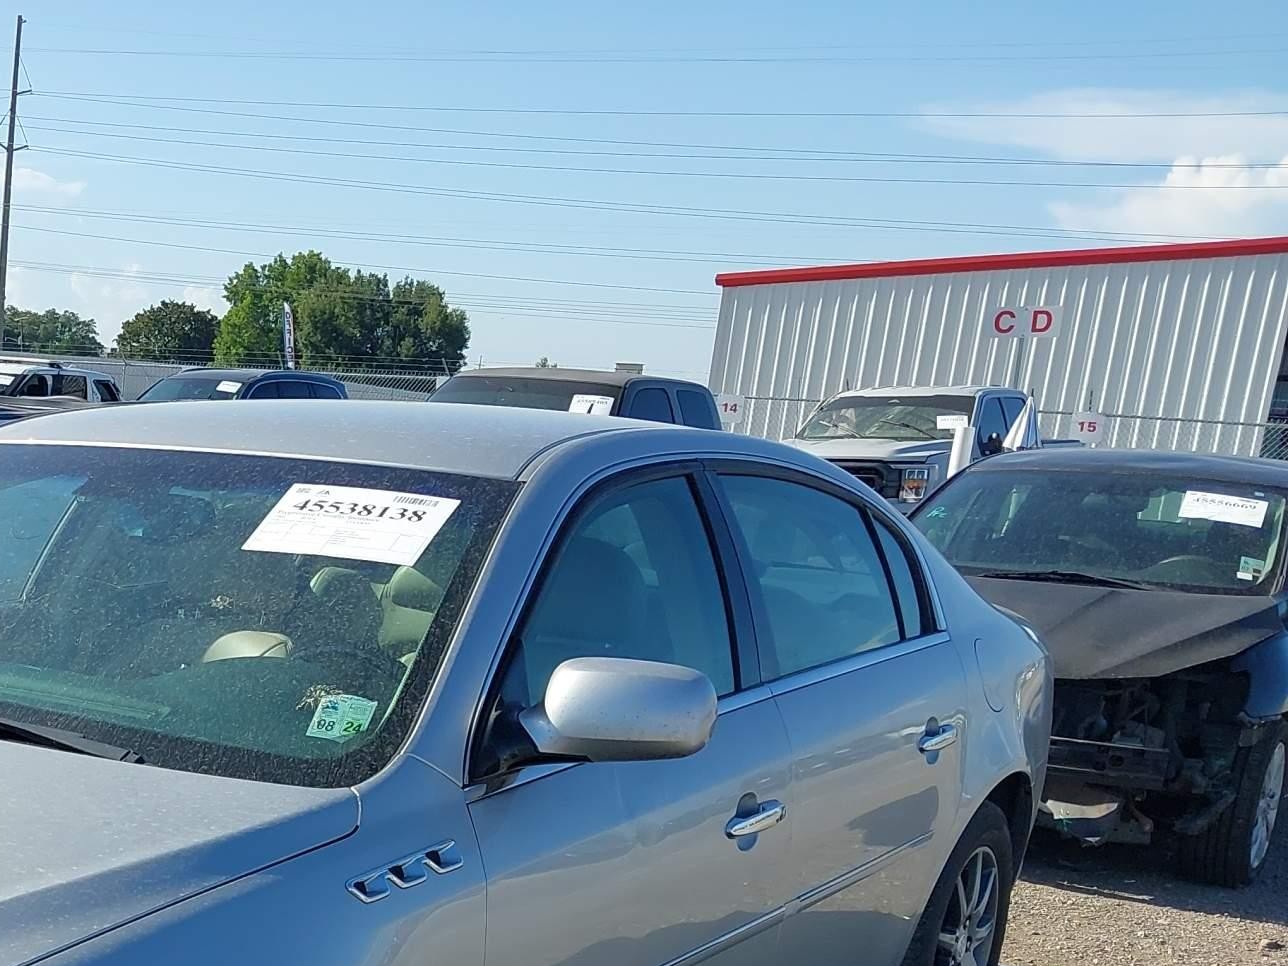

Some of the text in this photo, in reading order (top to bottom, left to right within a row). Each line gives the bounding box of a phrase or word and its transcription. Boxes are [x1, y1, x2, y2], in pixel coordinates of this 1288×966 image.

[994, 310, 1016, 334] C
[1030, 310, 1053, 333] D
[722, 402, 738, 413] 14
[1078, 421, 1097, 433] 15
[292, 498, 428, 523] 45538138
[316, 718, 336, 732] 08
[342, 721, 363, 734] 24
